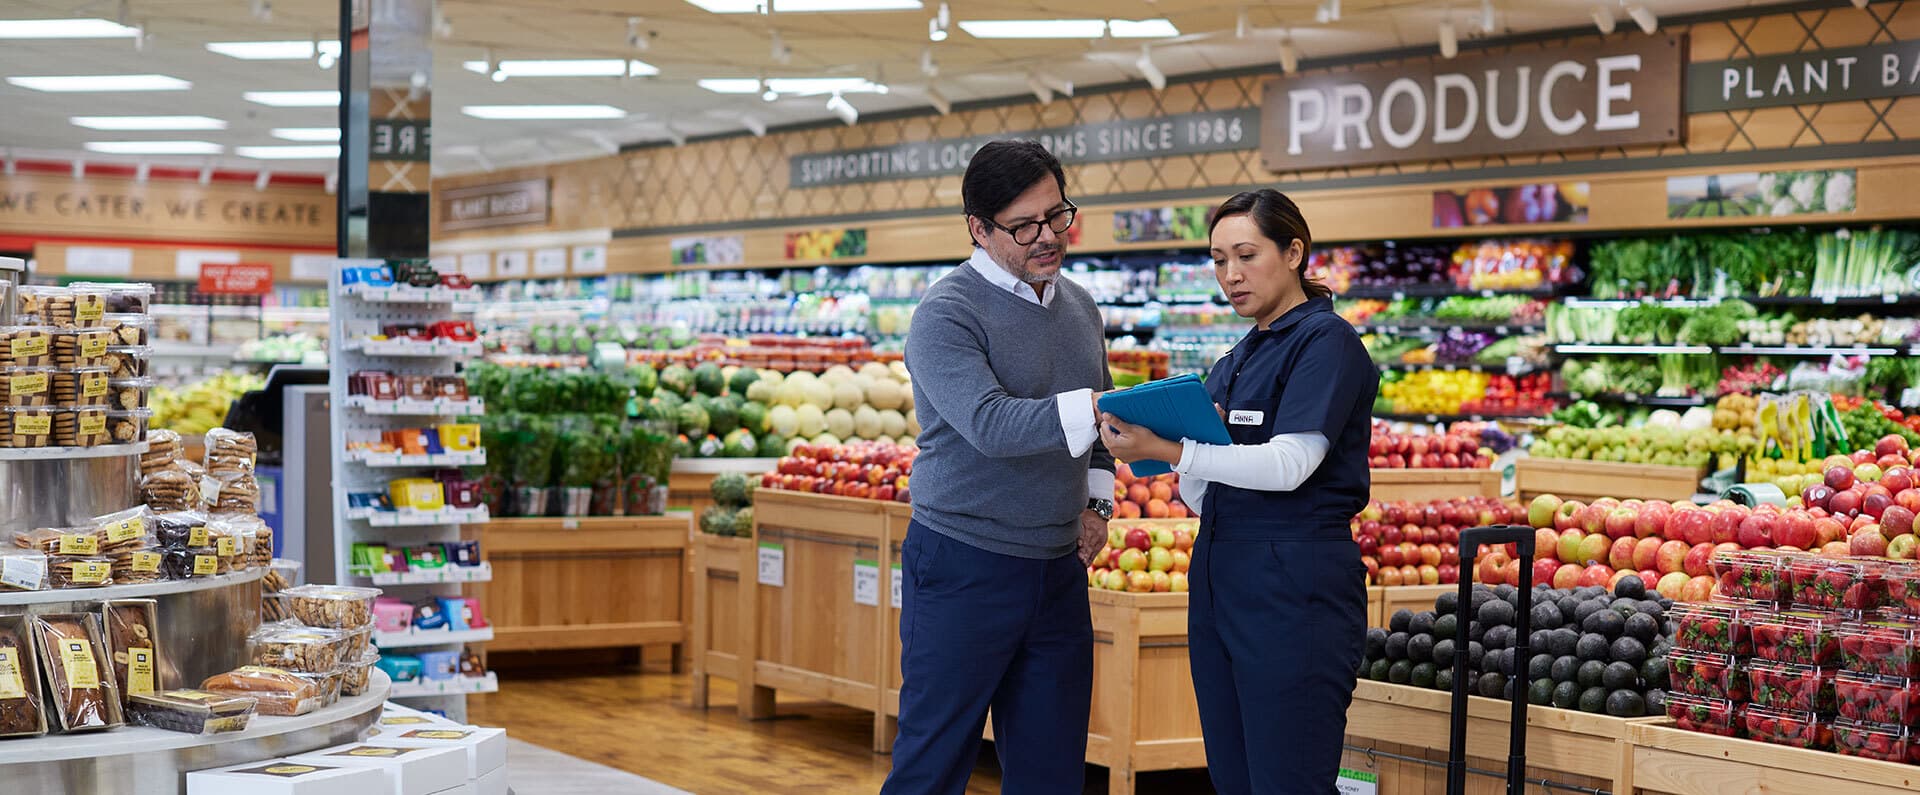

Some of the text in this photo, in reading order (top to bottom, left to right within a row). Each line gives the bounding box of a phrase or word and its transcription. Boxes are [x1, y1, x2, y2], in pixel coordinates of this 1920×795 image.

[1722, 57, 1858, 101] PLANT
[1287, 54, 1642, 155] PRODUCE
[801, 117, 1244, 183] SUPPORTING LOC RMS SINCE 1986
[0, 192, 38, 212] WE
[165, 198, 208, 219] WE
[221, 200, 321, 226] CREATE
[1233, 414, 1254, 423] ANNA
